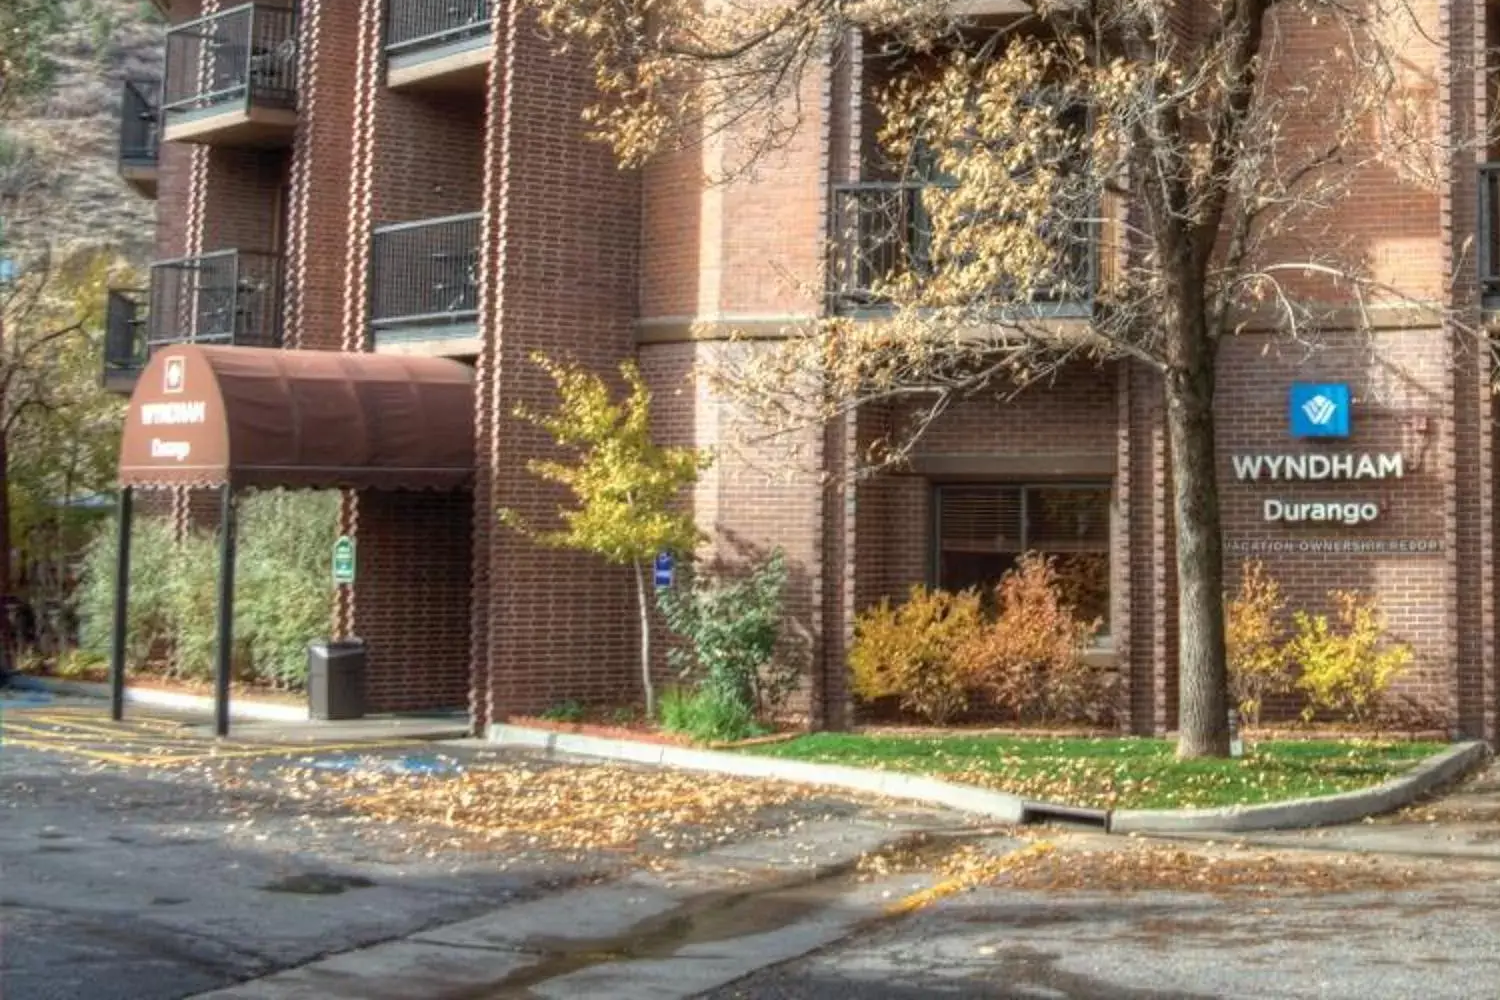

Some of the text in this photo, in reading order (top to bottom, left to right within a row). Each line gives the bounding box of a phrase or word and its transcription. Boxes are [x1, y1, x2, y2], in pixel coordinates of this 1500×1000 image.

[1232, 453, 1404, 480] WYNDHAM
[1263, 499, 1378, 524] Durango
[1224, 540, 1293, 552] VACATION
[1299, 540, 1384, 552] OWNERSHIP
